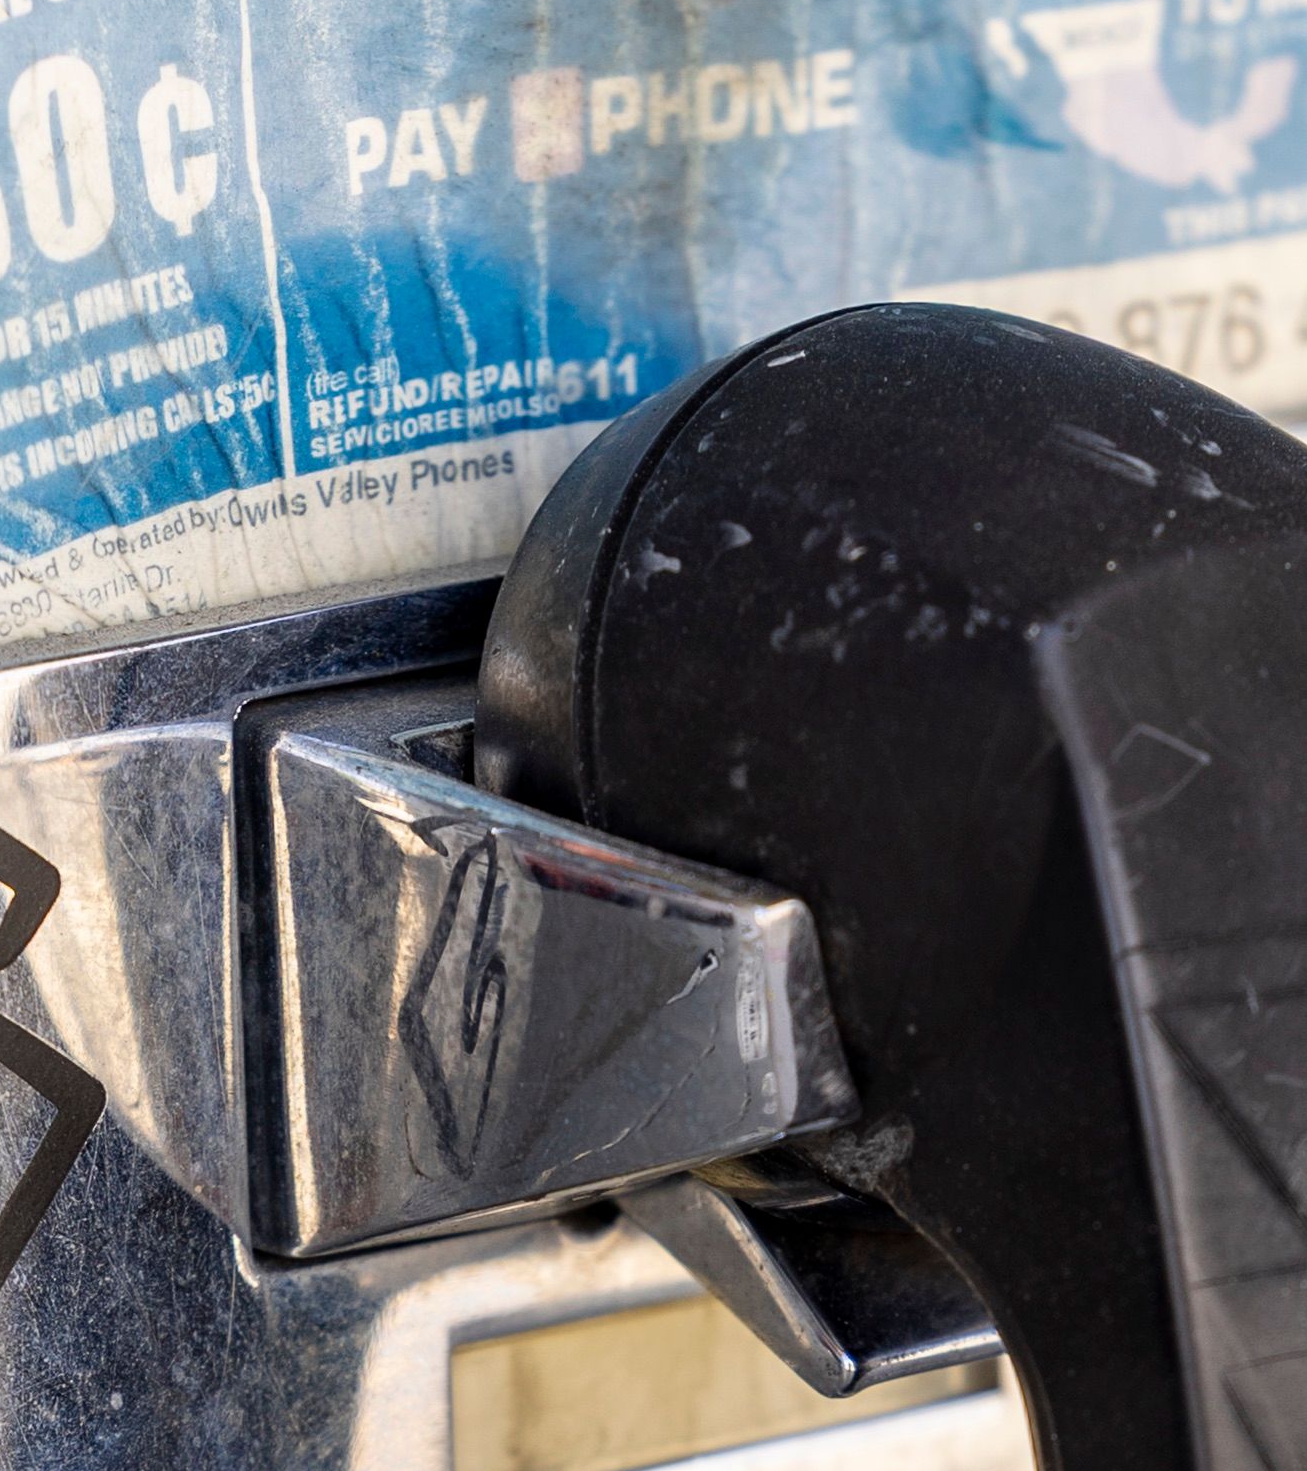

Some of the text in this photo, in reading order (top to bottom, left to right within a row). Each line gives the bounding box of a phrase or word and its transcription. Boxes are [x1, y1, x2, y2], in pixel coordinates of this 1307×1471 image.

[345, 49, 857, 197] PAY PHONE
[33, 300, 74, 349] 15
[554, 352, 640, 406] 611
[26, 406, 159, 480] INCOMING
[68, 547, 84, 572] &
[227, 495, 308, 529] Ows
